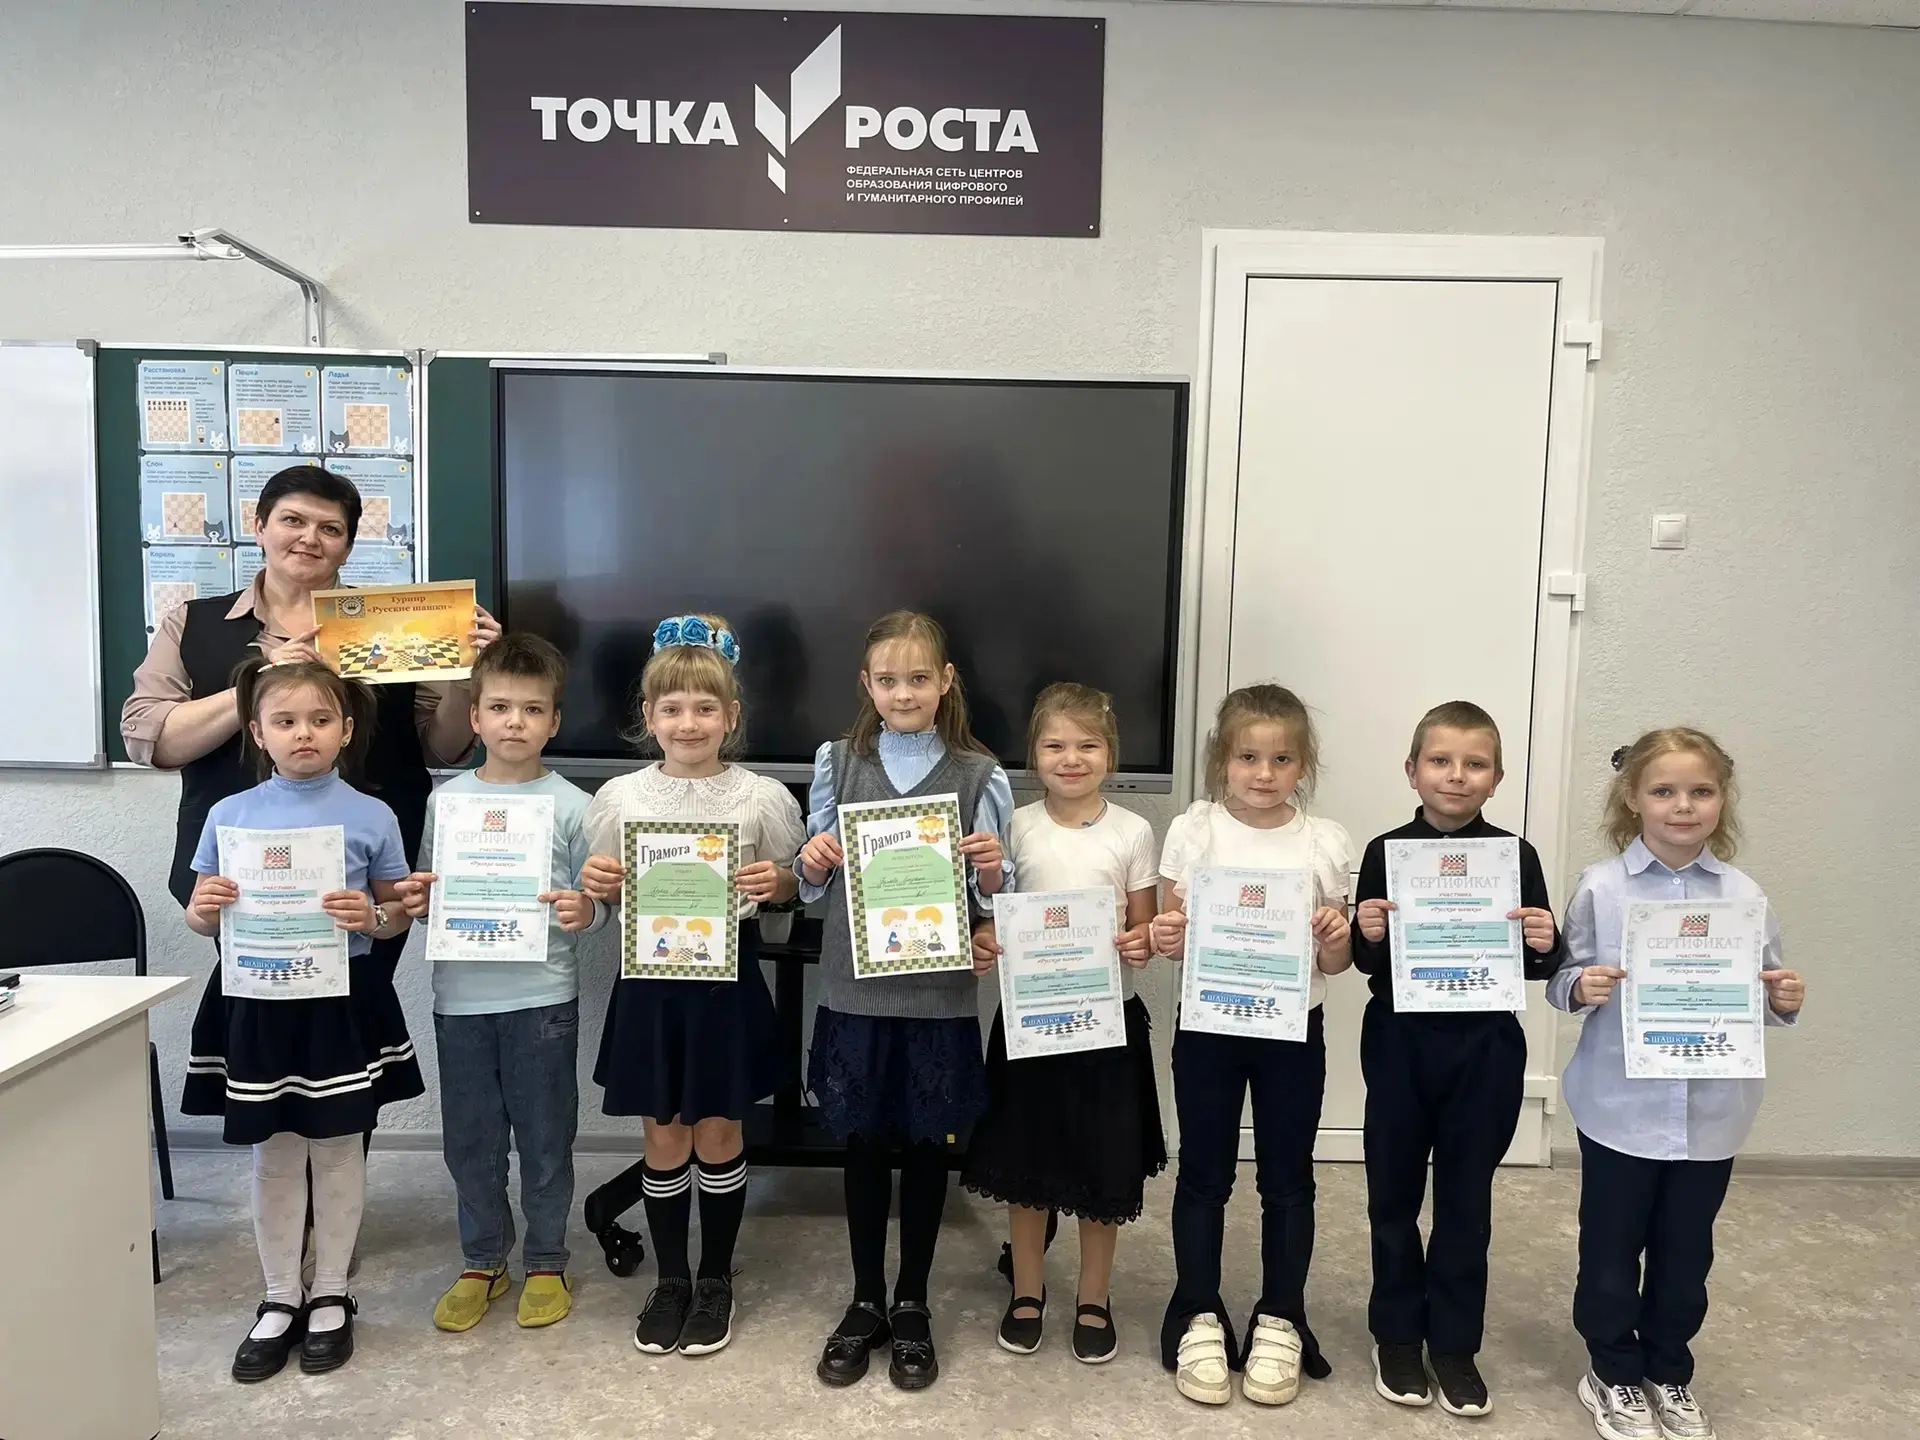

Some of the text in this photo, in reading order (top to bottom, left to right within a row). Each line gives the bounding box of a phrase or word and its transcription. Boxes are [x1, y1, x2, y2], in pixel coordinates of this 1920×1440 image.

[531, 96, 1040, 154] ТОЧКА РОСТА
[846, 165, 1023, 179] ФЕДЕРАЛЬНАЯ СЕТЬ ЦЕНТРОВ
[846, 179, 1008, 192] ОБРАЗОВАНИЯ ЦИФРОВОГО
[846, 193, 1024, 206] И ГУМАНИТАРНОГО ПРОФИЛЕЙ
[391, 595, 426, 604] Турнир
[454, 831, 536, 846] СЕРТИФИКАТ
[862, 829, 912, 858] Грамота
[640, 845, 691, 868] Грамота
[238, 867, 325, 882] СЕРТИФИКАТ
[1410, 876, 1501, 889] СЕРТИФИКАТ
[1209, 903, 1296, 922] СЕРТИФИКАТ
[1017, 926, 1100, 943] СЕРТИФИКАТ
[1646, 936, 1743, 949] СЕРТИФИКАТ
